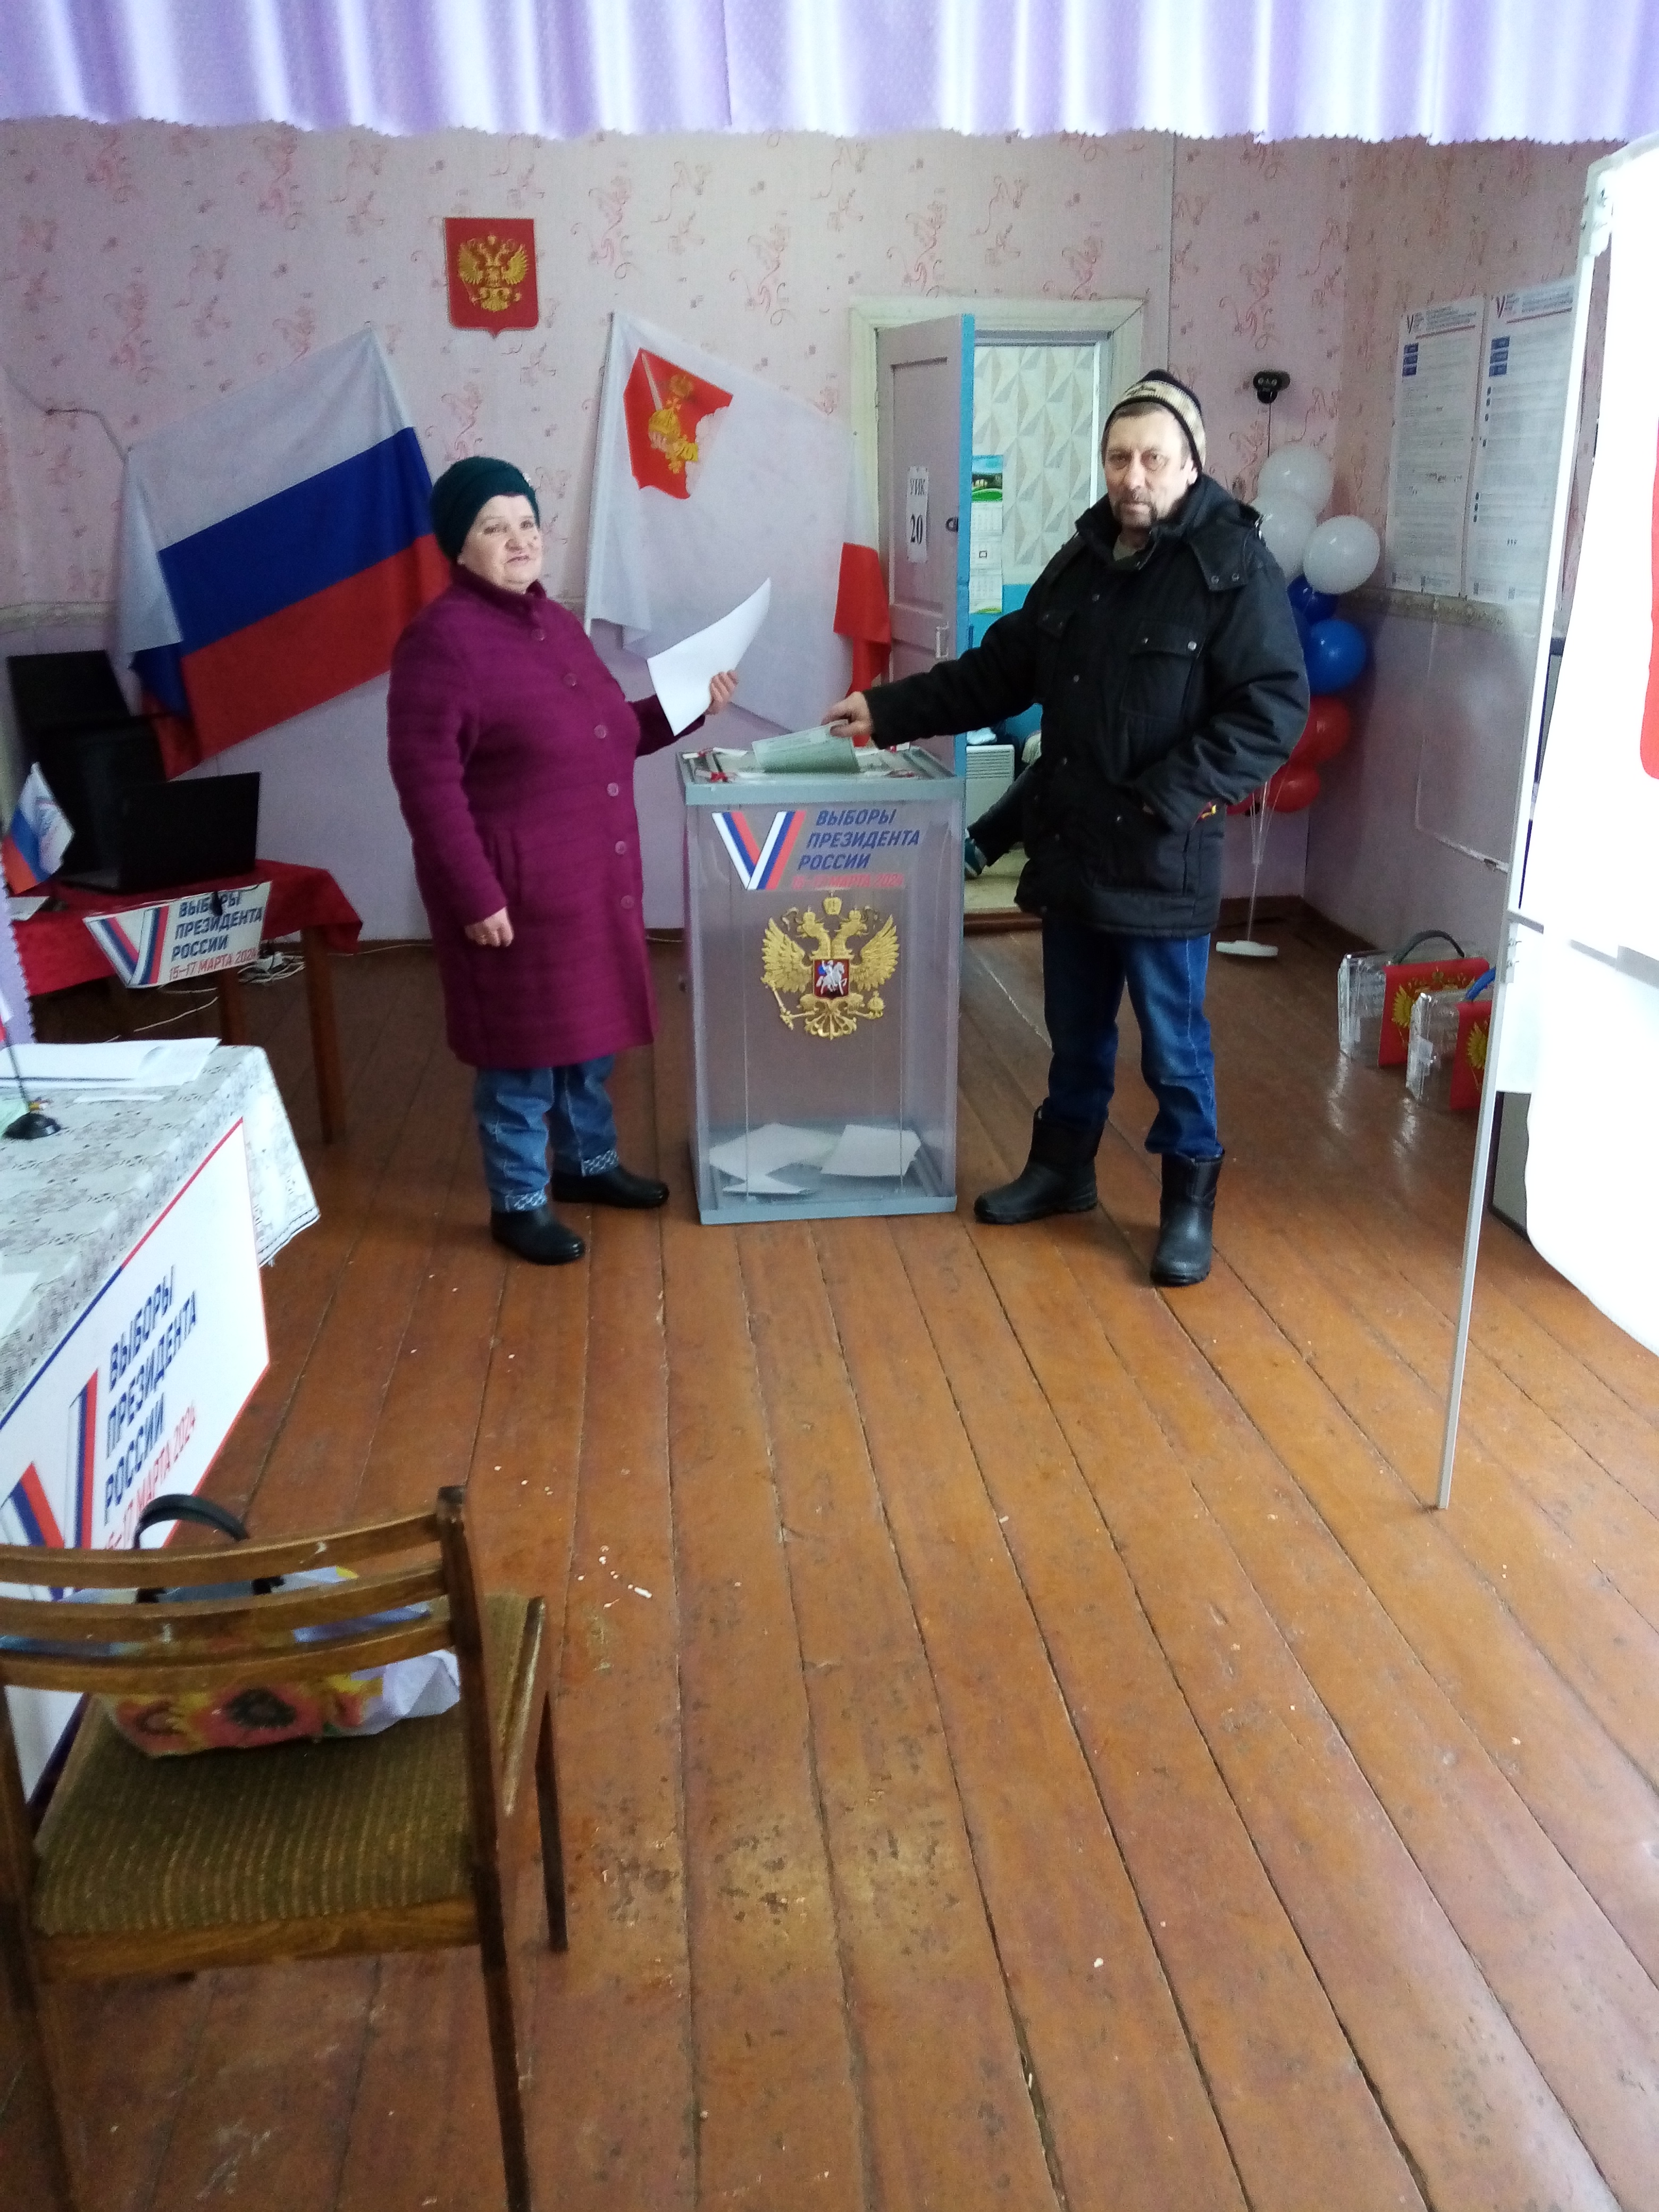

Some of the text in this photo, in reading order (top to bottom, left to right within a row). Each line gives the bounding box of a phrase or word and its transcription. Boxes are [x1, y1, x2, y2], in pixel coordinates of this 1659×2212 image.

[910, 514, 923, 545] 20
[816, 808, 896, 826] ВЫБОРЫ
[806, 830, 920, 849] ПРЕЗИДЕНТА
[797, 853, 871, 871] РОССИИ
[179, 890, 242, 918] ВЫБРЫ
[175, 907, 263, 940] ПРЕЗИДЕНТА
[171, 934, 229, 962] РОССИИ
[198, 953, 233, 973] МАРТА
[109, 1264, 174, 1393] ВЫБОРЫ
[106, 1290, 196, 1459] ПРЕЗИДЕНТА
[104, 1392, 164, 1526] РОССИИ
